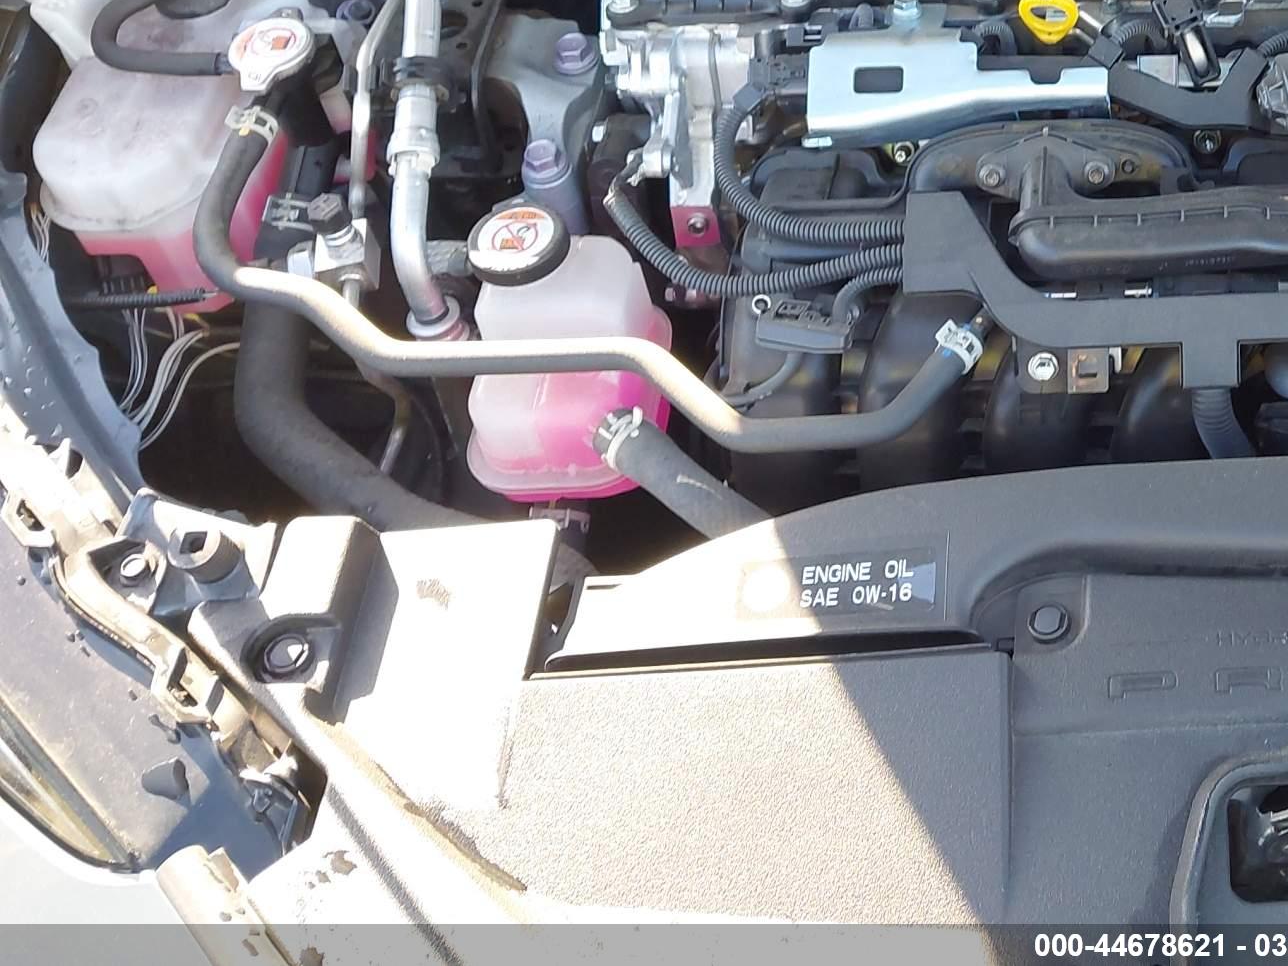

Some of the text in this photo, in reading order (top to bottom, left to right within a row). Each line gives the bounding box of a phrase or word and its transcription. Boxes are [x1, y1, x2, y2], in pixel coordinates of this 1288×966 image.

[802, 559, 914, 585] ENGINE OIL
[799, 588, 839, 608] SAE
